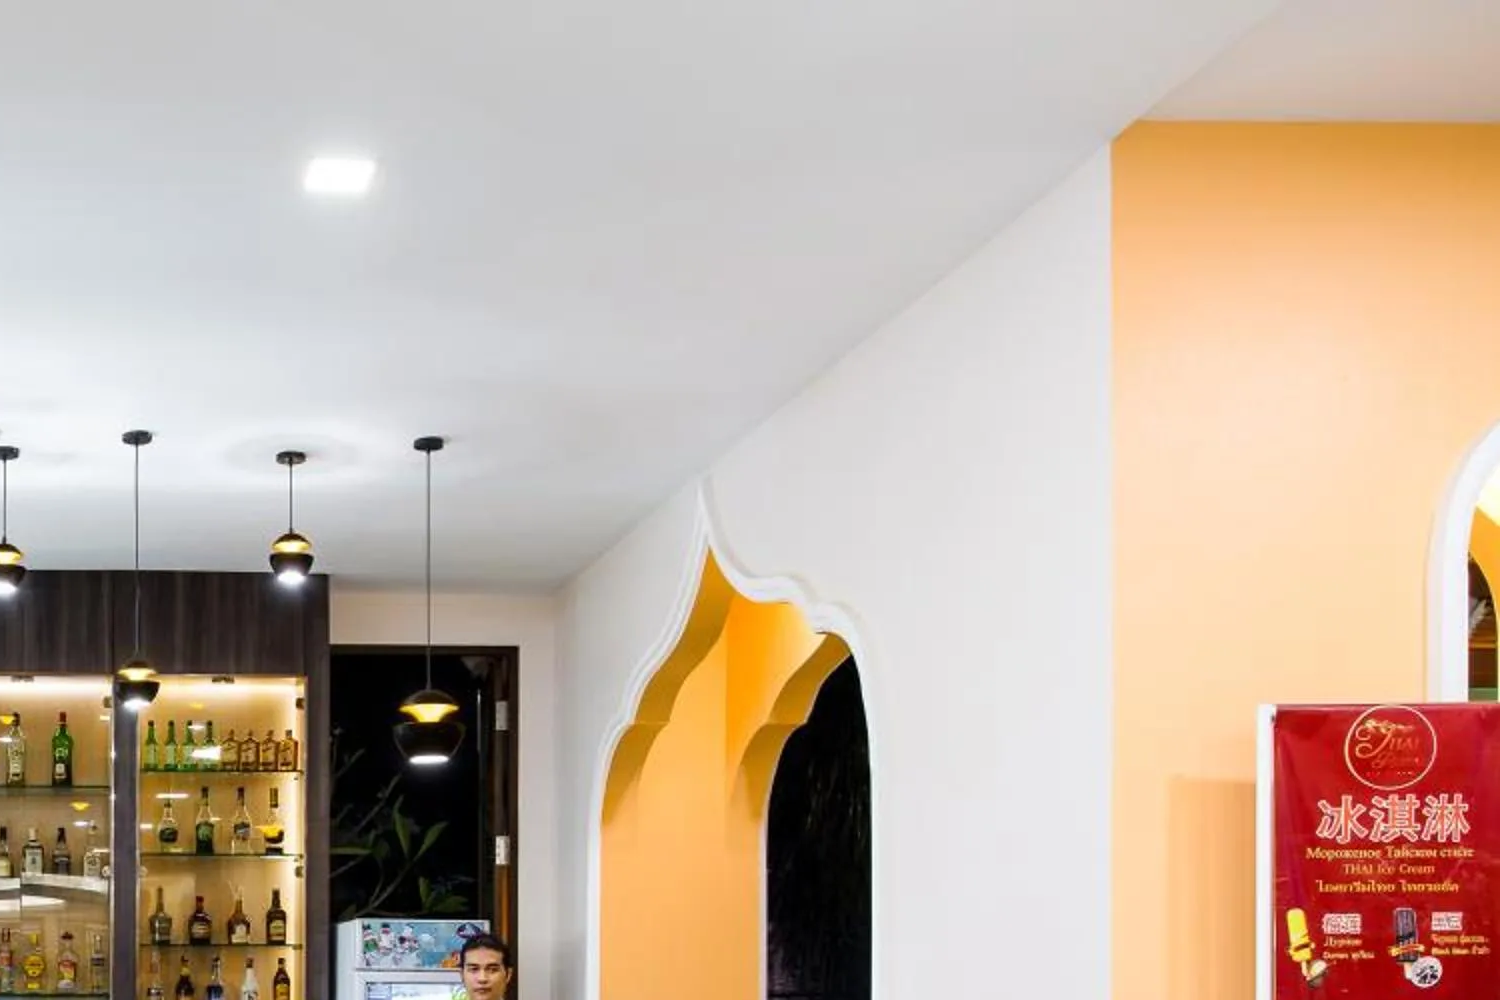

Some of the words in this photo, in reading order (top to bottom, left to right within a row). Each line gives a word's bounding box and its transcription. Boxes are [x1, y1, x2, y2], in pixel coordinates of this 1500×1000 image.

[1316, 794, 1470, 844] 冰淇淋
[1344, 864, 1373, 874] THAI
[1377, 864, 1395, 874] Ice
[1399, 864, 1436, 874] Cream
